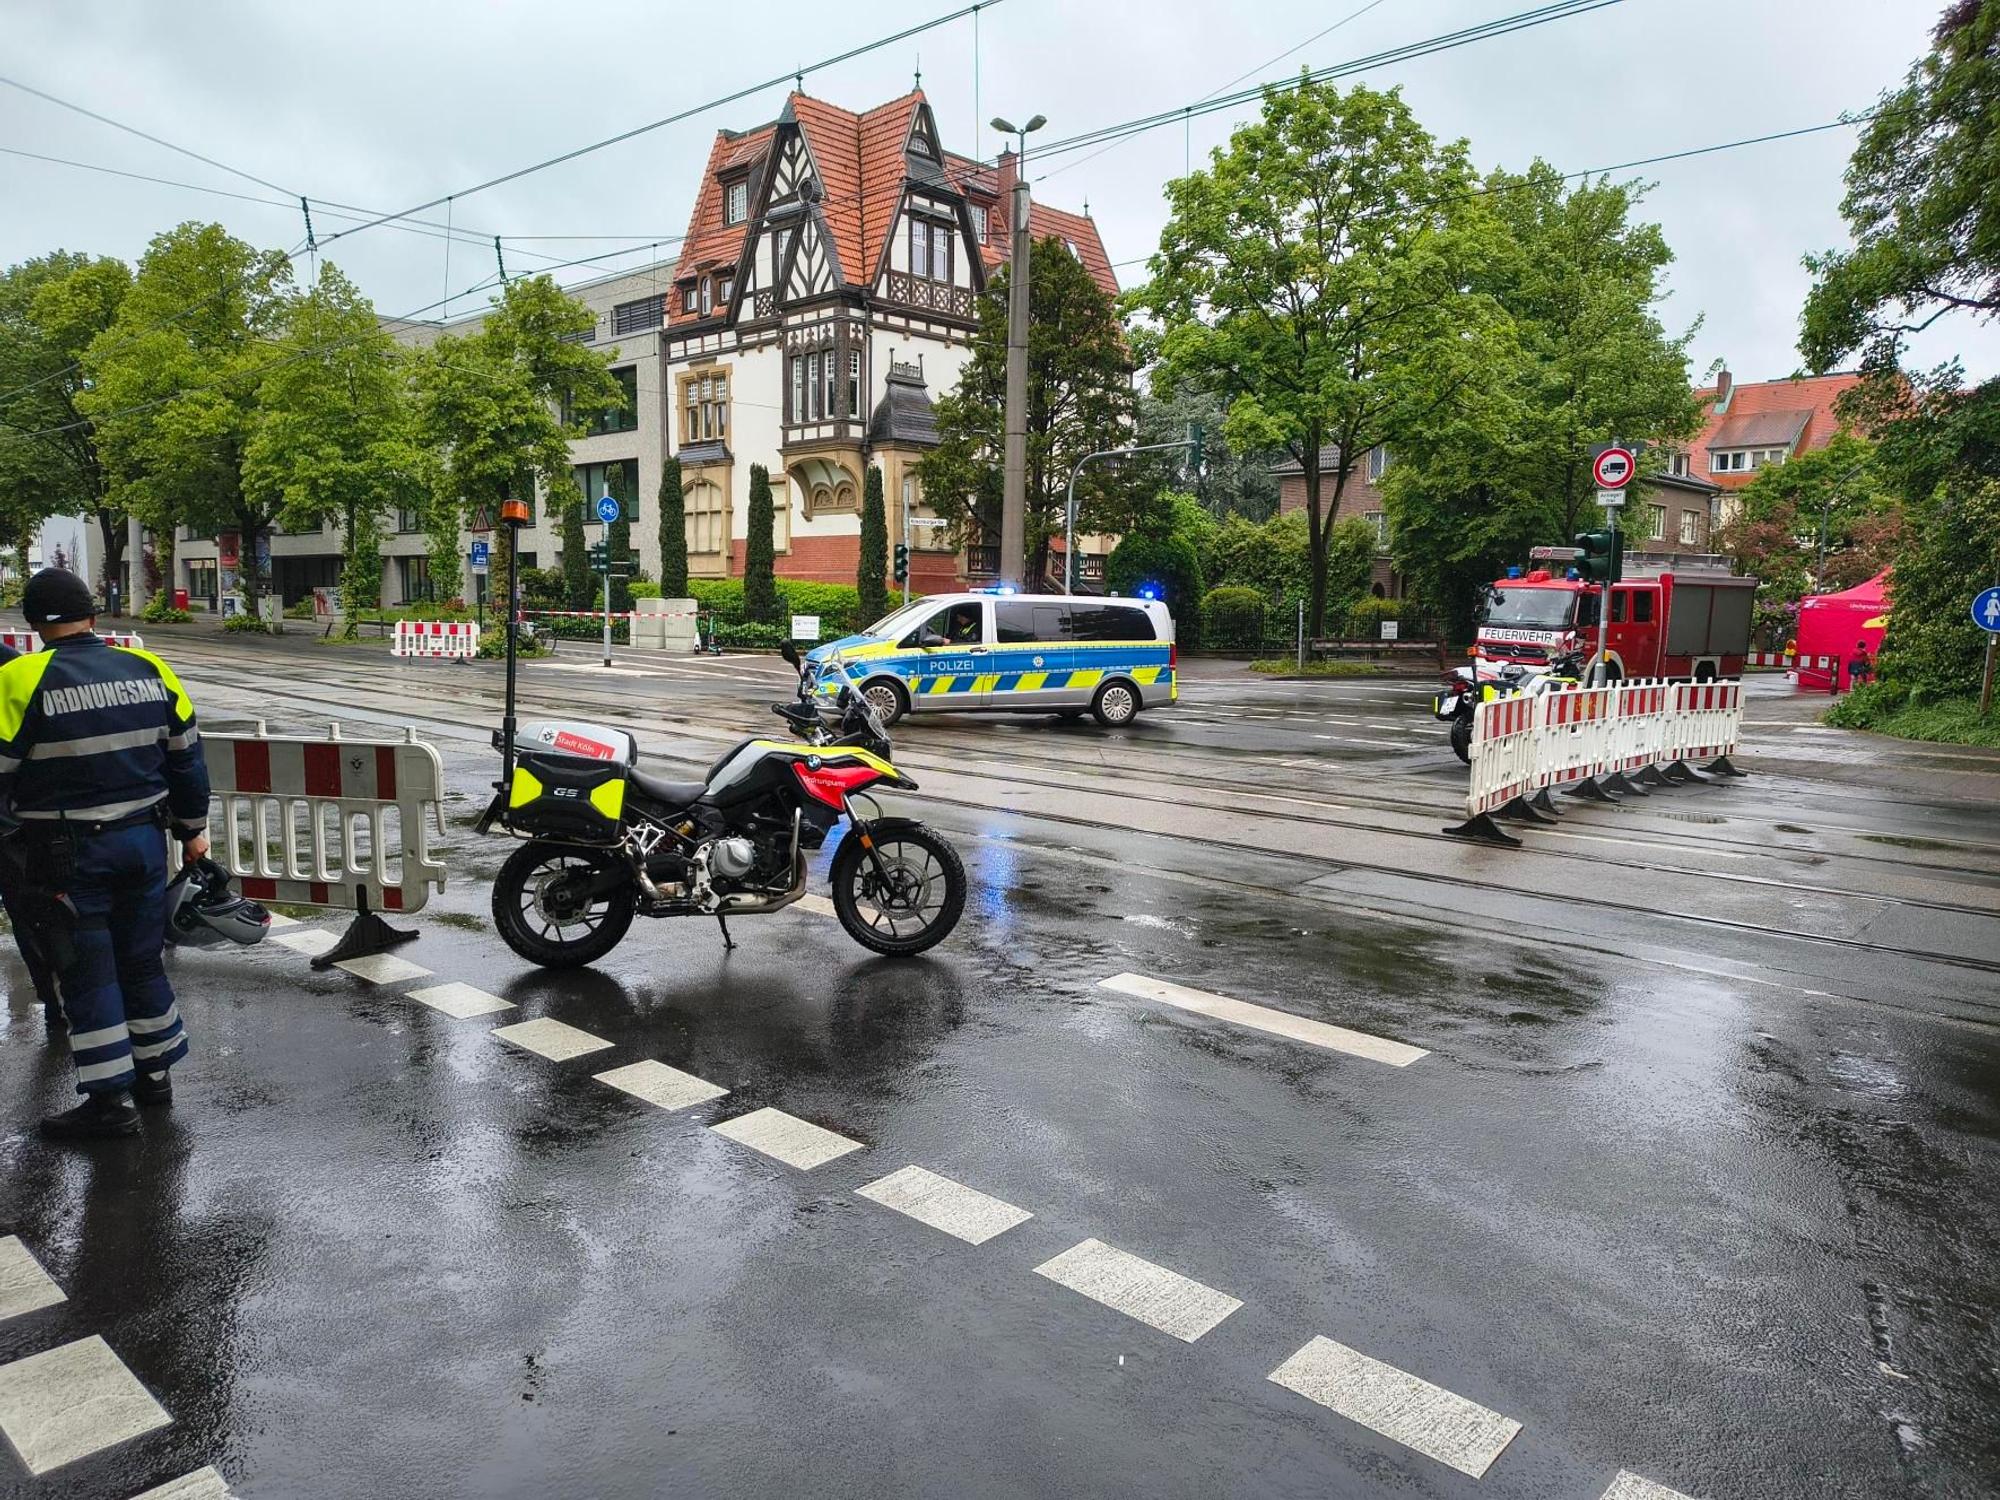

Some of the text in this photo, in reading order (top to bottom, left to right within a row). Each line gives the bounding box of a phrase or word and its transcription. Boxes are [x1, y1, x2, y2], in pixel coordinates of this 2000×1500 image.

[1484, 629, 1553, 642] FEUERWEHR
[930, 660, 974, 671] POLIZEI
[43, 678, 168, 717] ORDNUNGSAMT
[557, 735, 596, 753] Stadt Köln
[553, 788, 579, 797] GS
